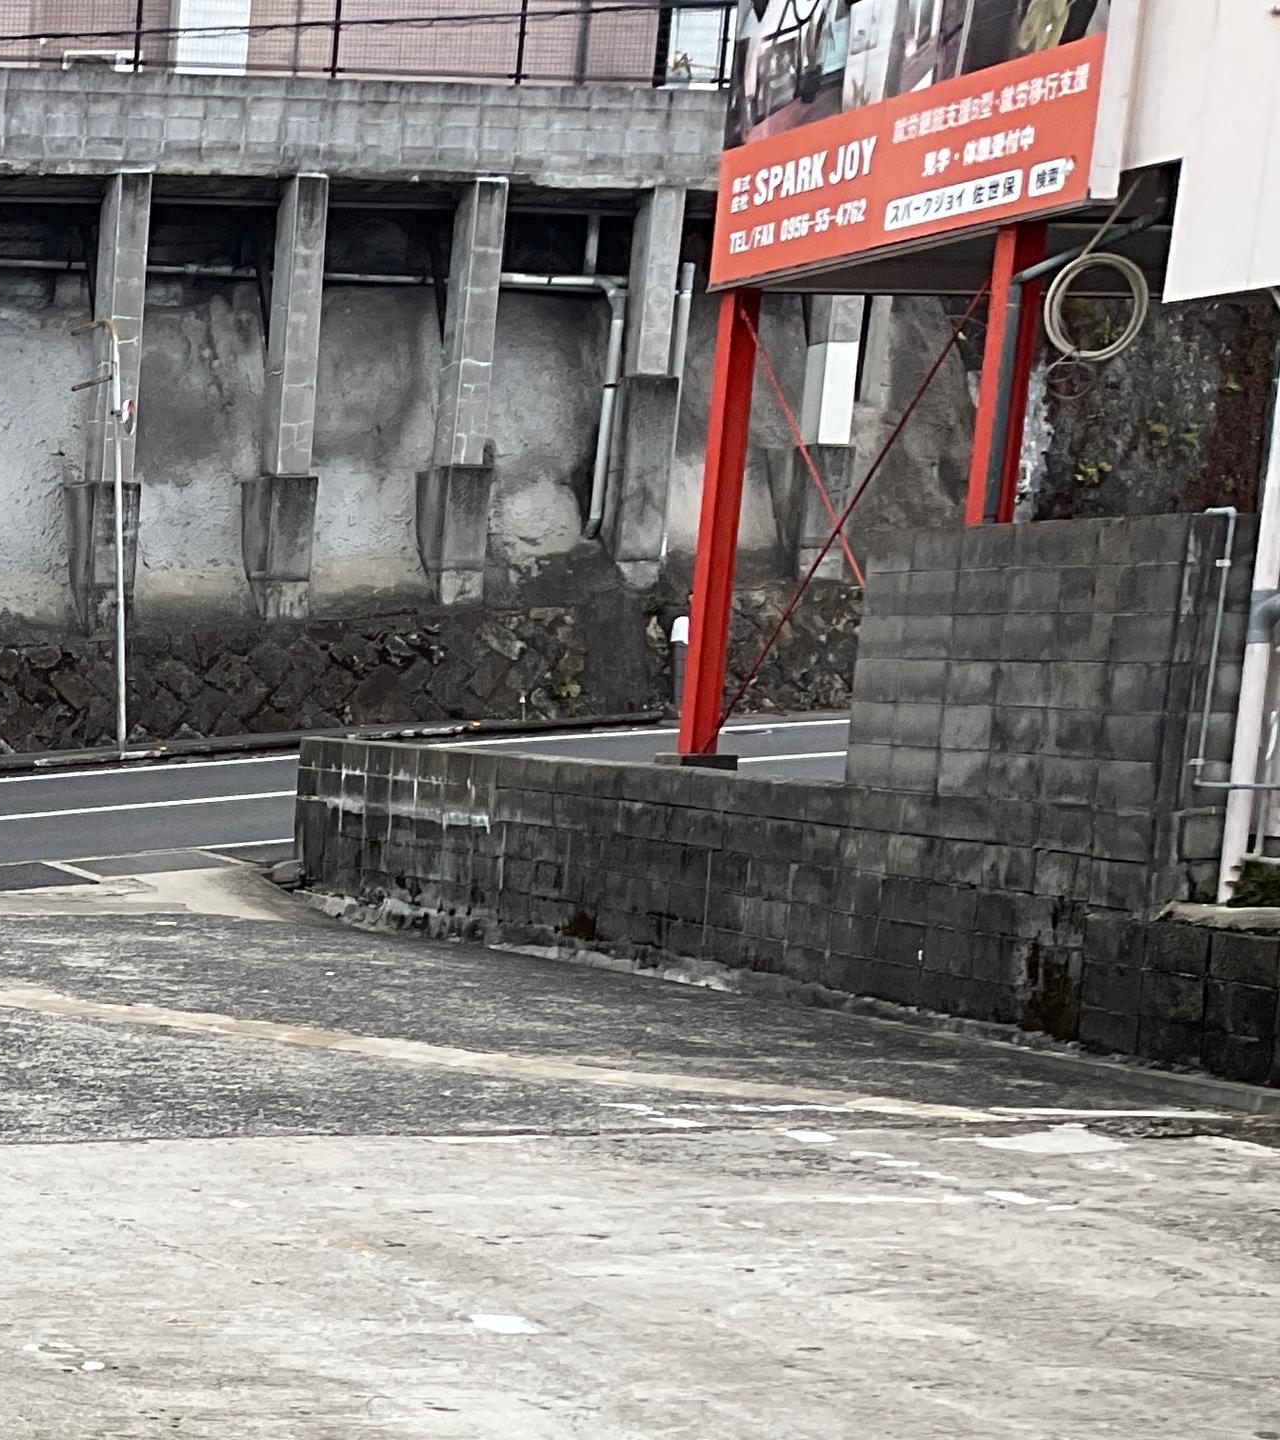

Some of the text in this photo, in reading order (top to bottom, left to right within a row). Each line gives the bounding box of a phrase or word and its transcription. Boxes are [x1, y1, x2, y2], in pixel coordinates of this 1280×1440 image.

[753, 135, 878, 206] SPARK JOY
[729, 222, 776, 255] TEL/FAX
